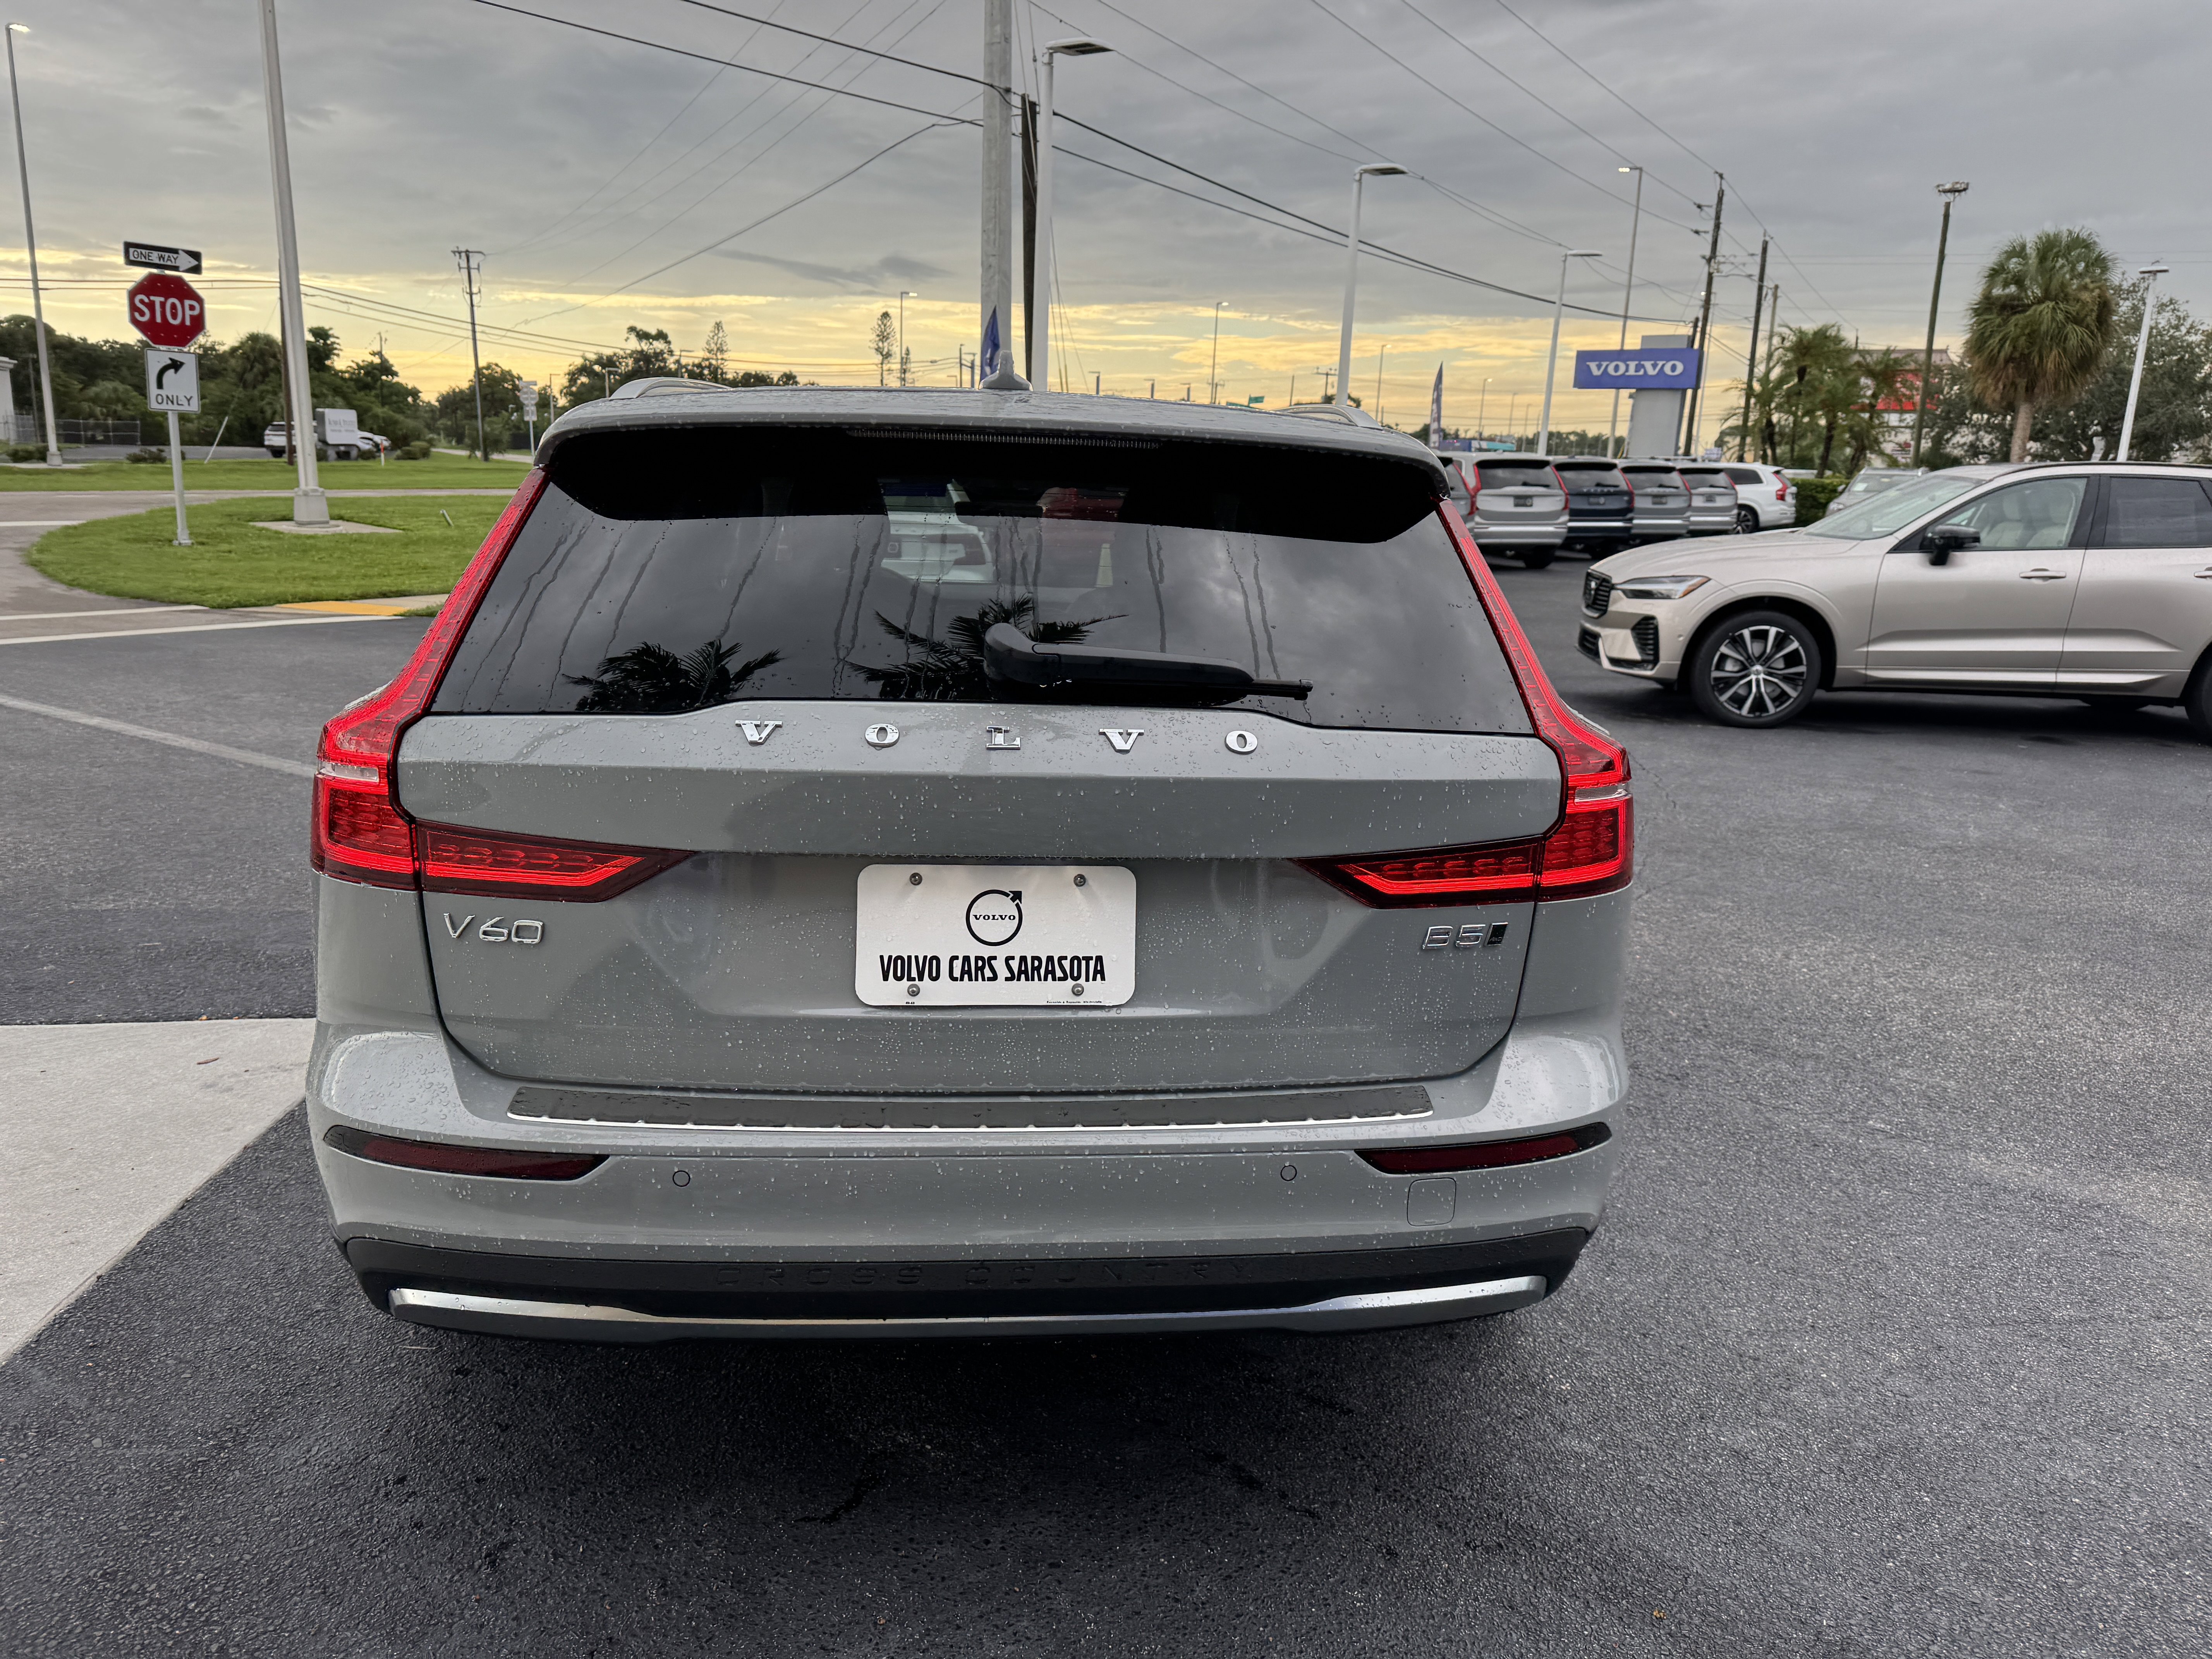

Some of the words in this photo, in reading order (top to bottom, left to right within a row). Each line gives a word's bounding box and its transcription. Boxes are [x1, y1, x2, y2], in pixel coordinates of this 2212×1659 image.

[132, 249, 153, 261] ONE
[157, 253, 179, 264] WAY
[134, 294, 200, 326] STOP
[1586, 361, 1684, 376] VOLVO
[156, 393, 193, 407] ONLY
[735, 720, 1259, 754] VOLVO
[443, 913, 543, 944] V60
[1422, 924, 1486, 949] B5
[879, 955, 941, 982] VOLVO
[948, 955, 998, 982] CARS
[1005, 955, 1106, 982] SARASOTA
[717, 1267, 923, 1285] CROSS
